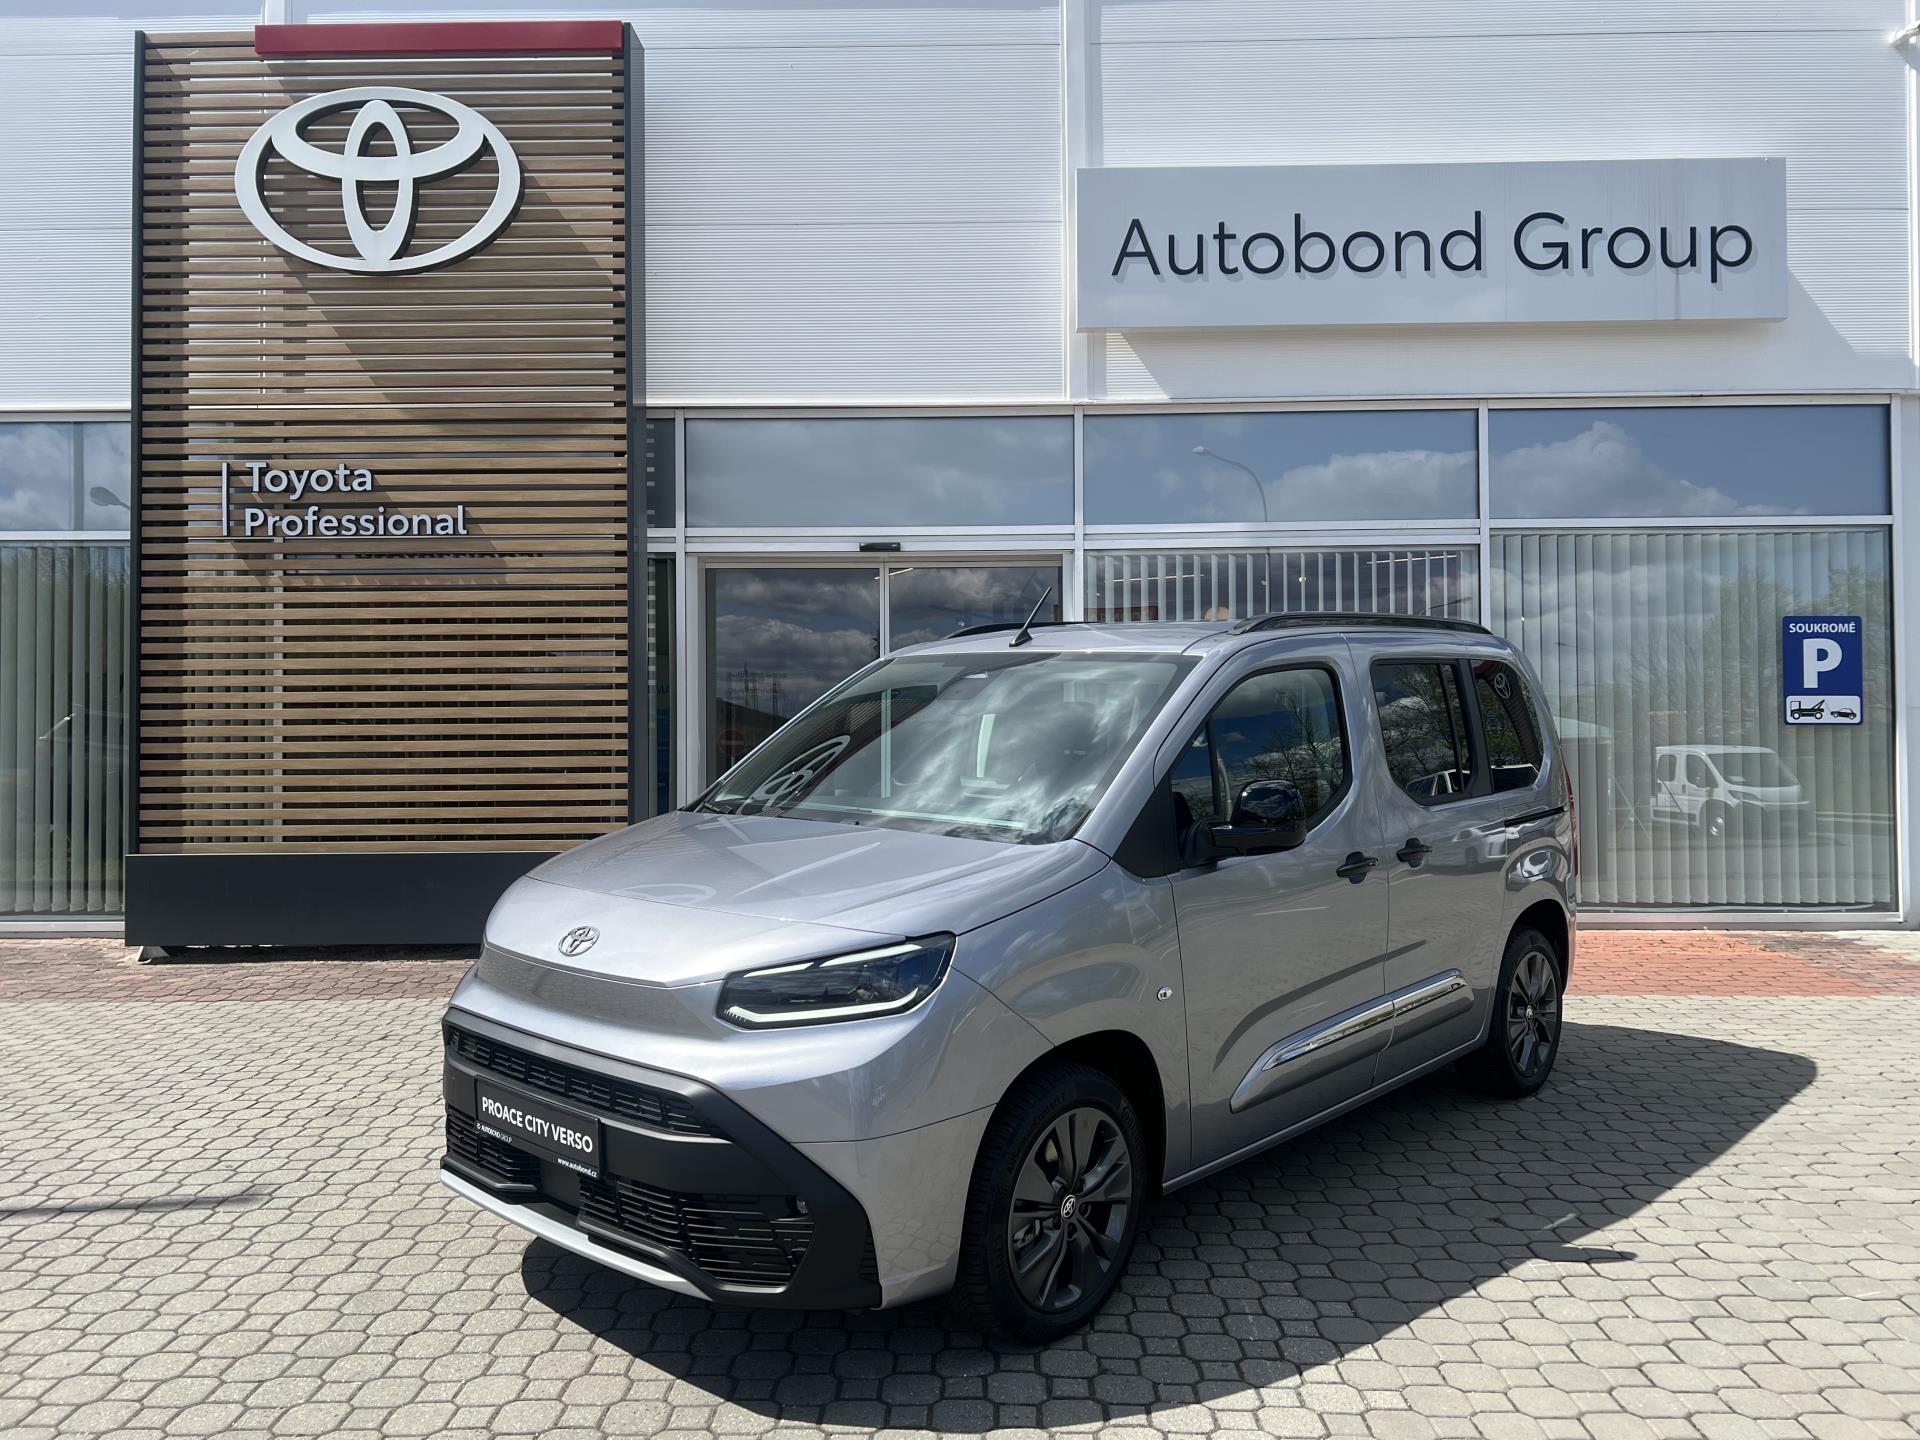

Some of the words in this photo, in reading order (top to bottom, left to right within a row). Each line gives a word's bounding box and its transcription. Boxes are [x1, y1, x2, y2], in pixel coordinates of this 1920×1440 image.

[1111, 210, 1483, 276] Autobond
[1513, 211, 1753, 284] Group
[245, 461, 374, 501] Toyota
[244, 505, 468, 537] Professional
[1788, 621, 1857, 633] SOUKROMÉ
[1803, 637, 1843, 689] P
[482, 1096, 524, 1128] PROACE
[524, 1115, 550, 1138] CITY
[551, 1123, 593, 1153] VERSO
